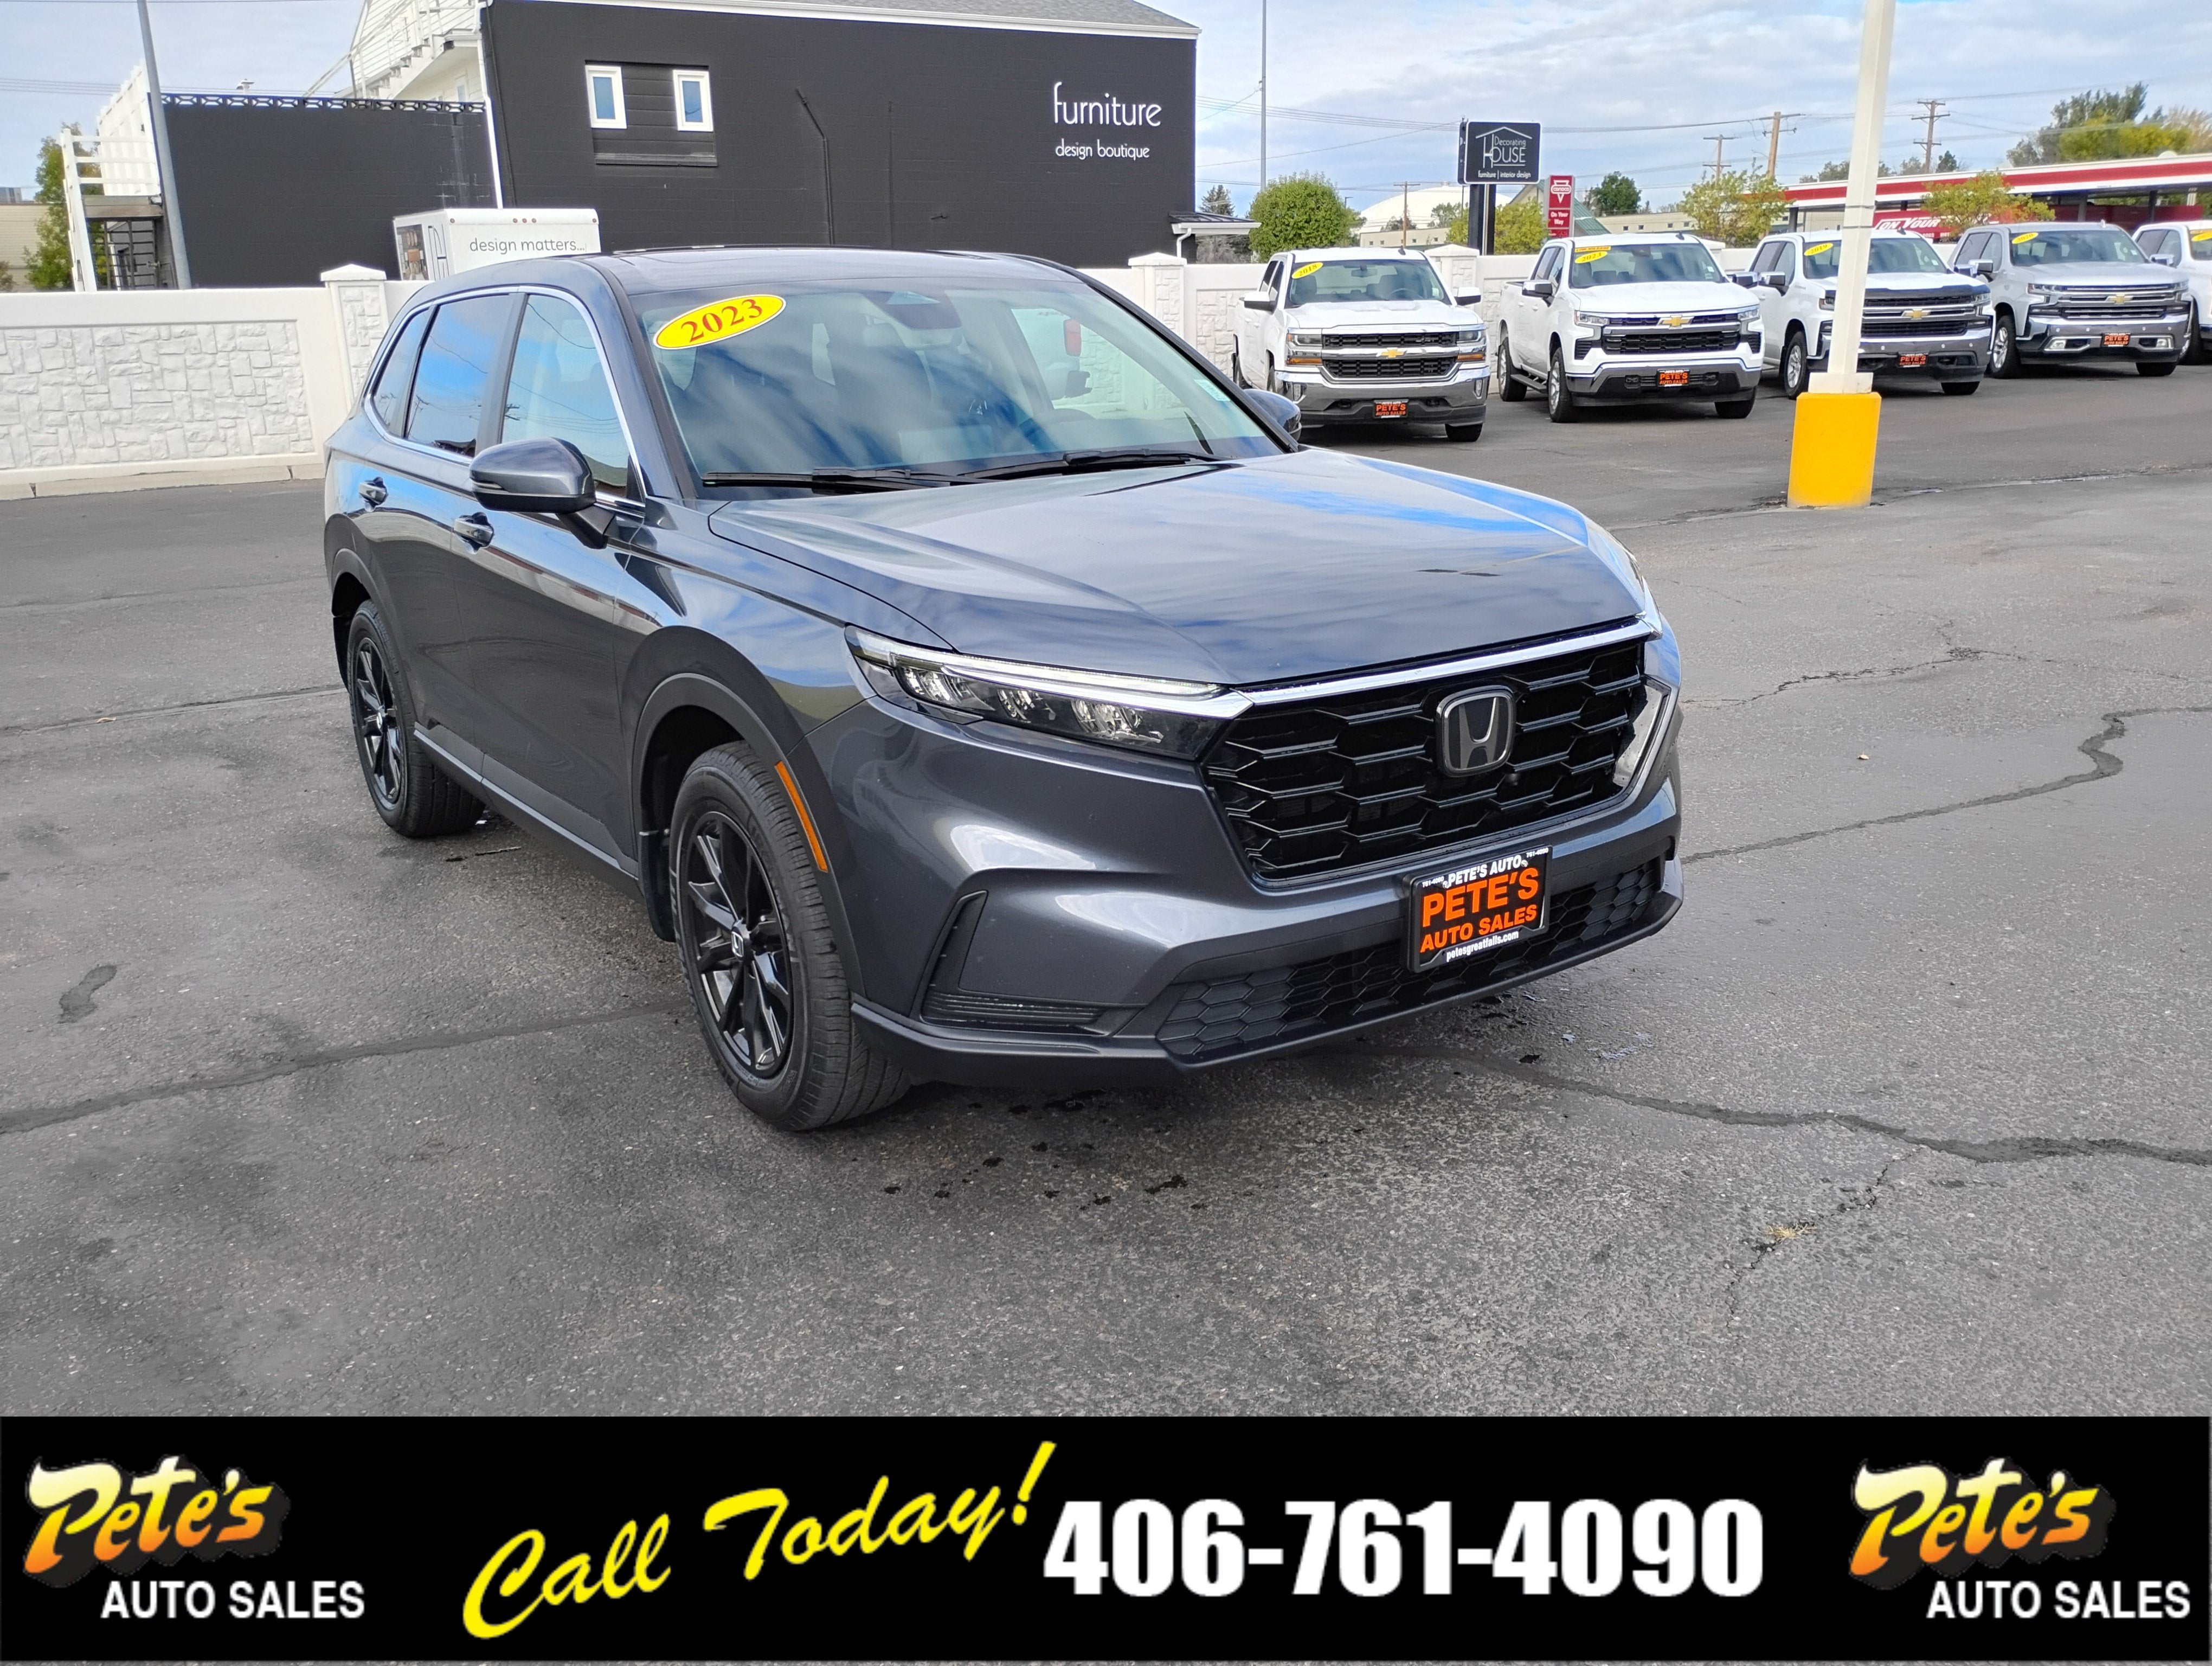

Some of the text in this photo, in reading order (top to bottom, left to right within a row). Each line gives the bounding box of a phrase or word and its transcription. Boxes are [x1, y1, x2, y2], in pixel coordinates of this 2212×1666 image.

[1053, 81, 1162, 127] furniture
[1055, 138, 1150, 161] design boutique
[1494, 136, 1527, 148] Decorating
[1477, 170, 1497, 178] furniture
[1516, 170, 1531, 179] design
[470, 238, 517, 254] design
[1298, 264, 1317, 277] 2018
[681, 299, 763, 343] 2023
[1375, 403, 1406, 412] PETE'S
[1448, 865, 1488, 887] PETE'S
[1489, 855, 1522, 876] AUTO
[1422, 868, 1540, 928] PETE'S
[1420, 904, 1538, 953] AUTO SALES
[1446, 931, 1519, 963] petesgreatfalls.com
